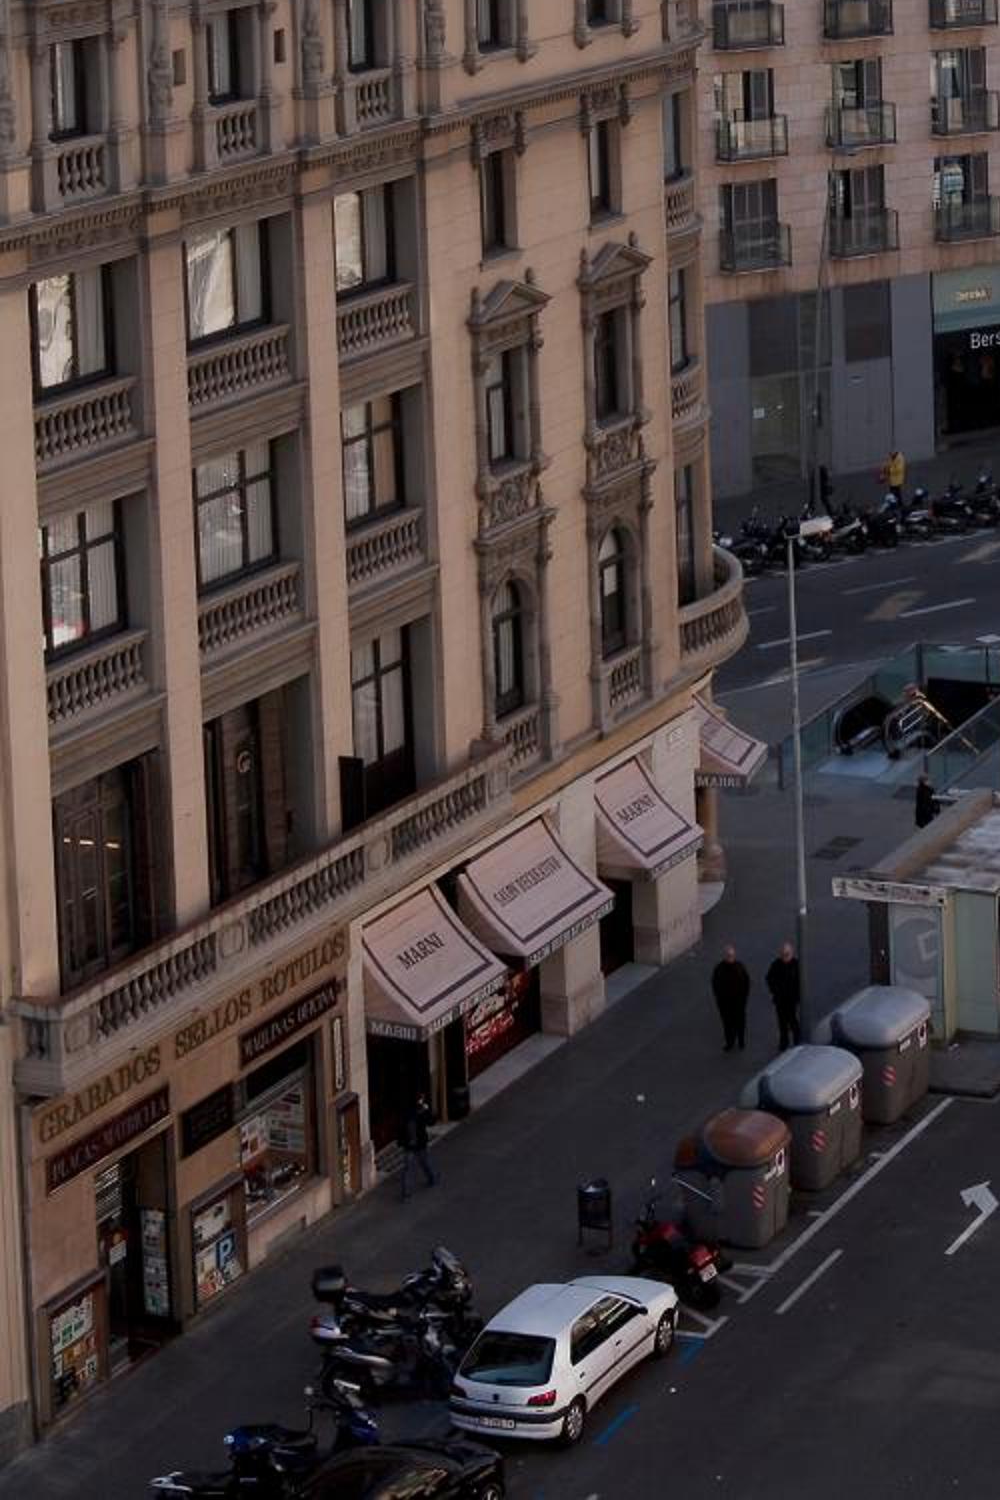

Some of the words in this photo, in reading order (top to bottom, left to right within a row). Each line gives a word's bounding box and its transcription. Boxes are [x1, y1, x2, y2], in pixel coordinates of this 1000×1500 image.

[616, 793, 658, 825] MARNI
[394, 931, 445, 970] MARNI
[39, 1043, 162, 1145] GRABADOS
[174, 990, 252, 1060] SELLOS
[259, 930, 347, 1007] ROTULOS
